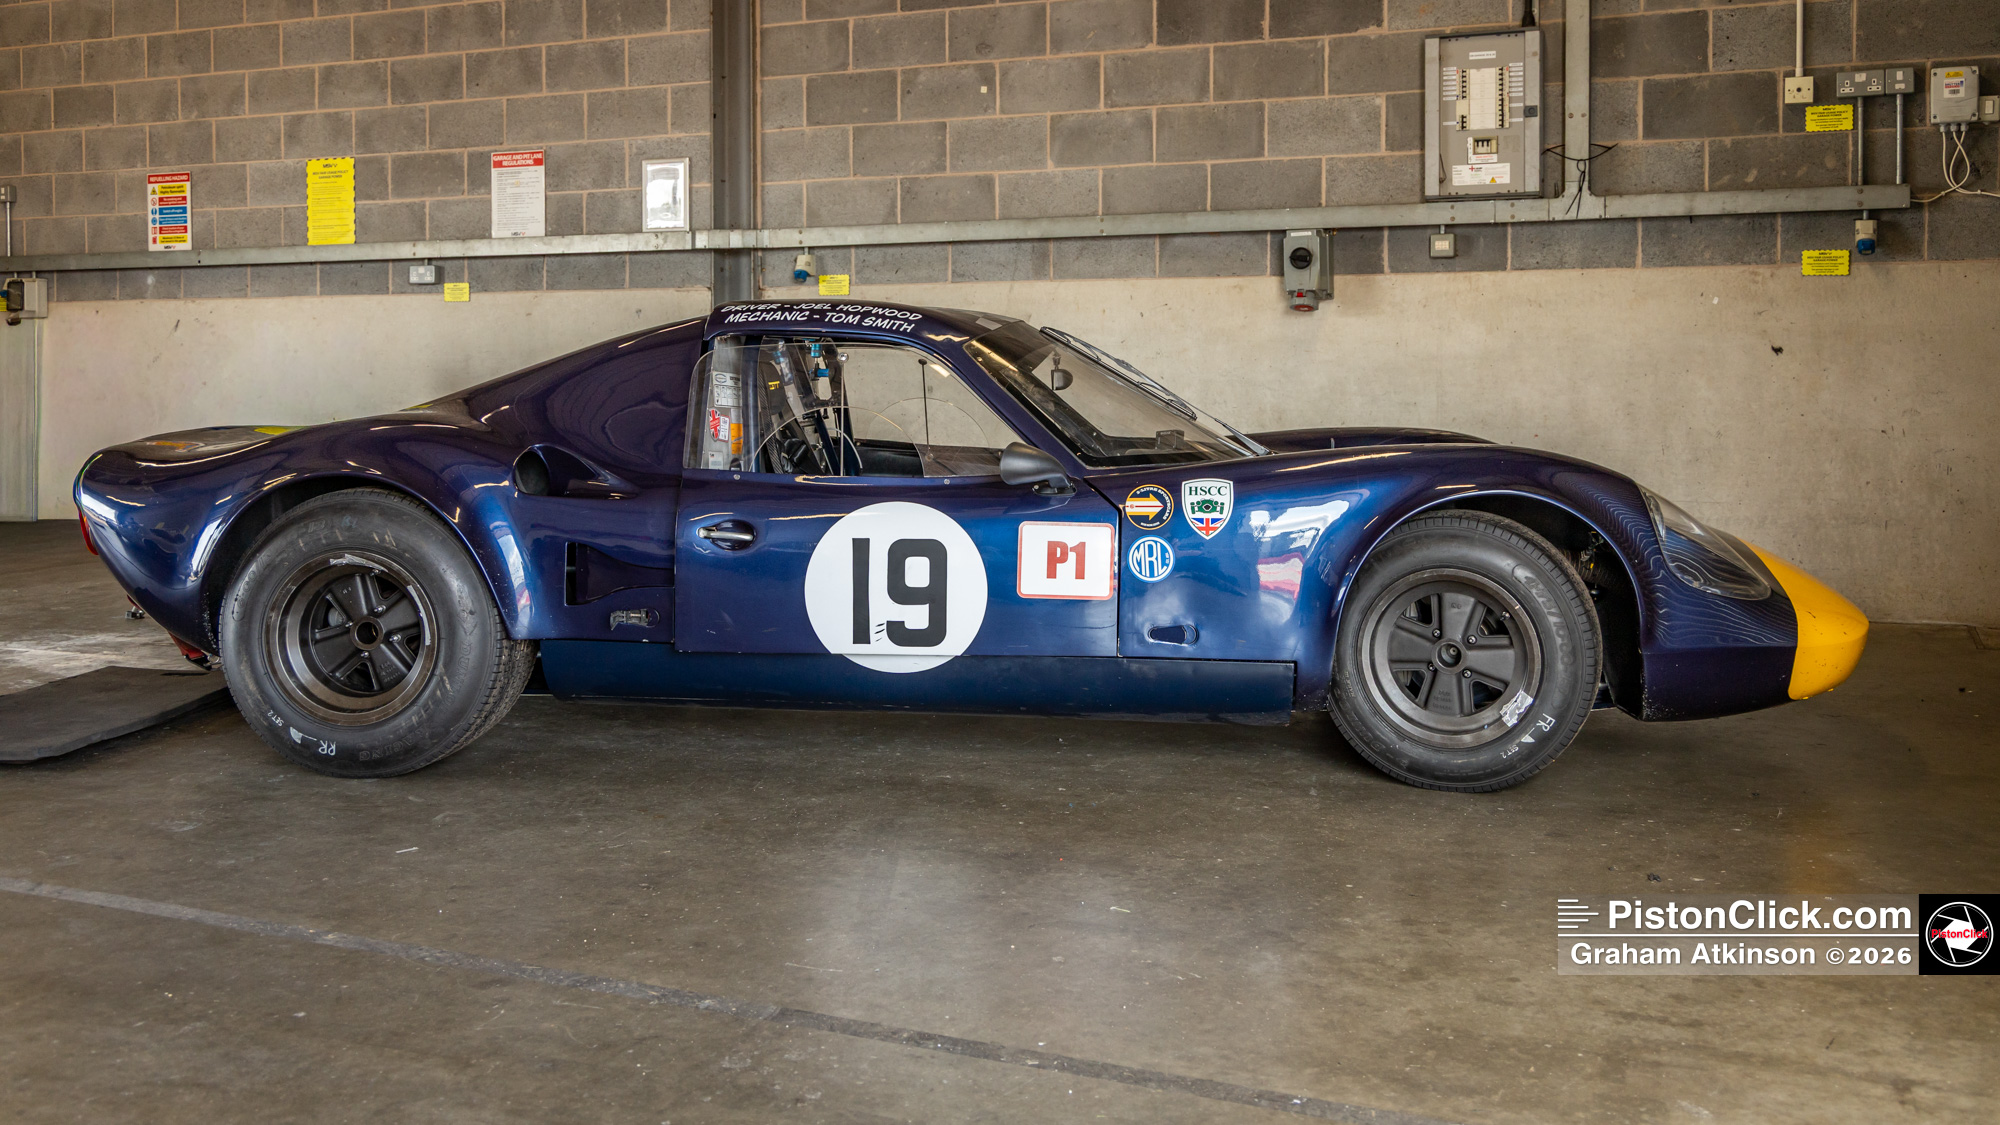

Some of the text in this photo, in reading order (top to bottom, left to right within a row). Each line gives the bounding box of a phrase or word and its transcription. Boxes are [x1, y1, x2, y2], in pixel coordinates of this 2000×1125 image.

[721, 303, 782, 312] DRIVER
[836, 304, 923, 321] HOPWOOD
[725, 311, 810, 324] MECHANIC
[824, 312, 859, 324] TOM
[862, 316, 915, 333] SMITH
[1188, 486, 1227, 496] HSCC
[1046, 540, 1086, 580] P1
[1133, 541, 1168, 578] MRL
[852, 537, 948, 648] 19
[272, 715, 284, 726] SET
[1536, 713, 1556, 732] FR
[318, 740, 336, 756] RR
[1507, 744, 1519, 756] SET
